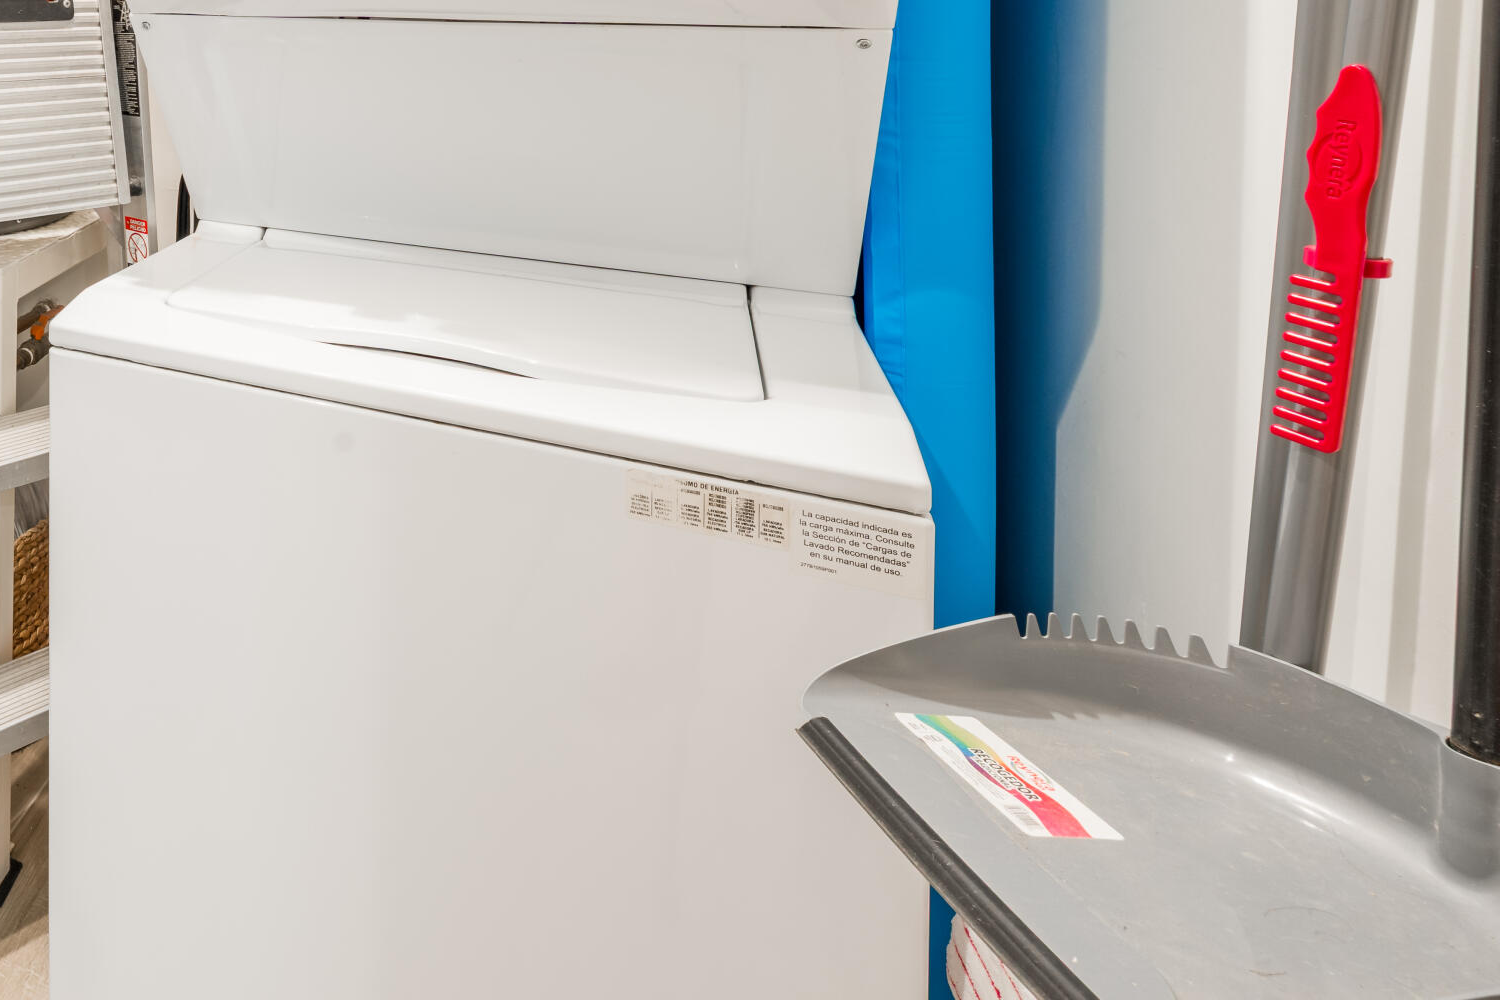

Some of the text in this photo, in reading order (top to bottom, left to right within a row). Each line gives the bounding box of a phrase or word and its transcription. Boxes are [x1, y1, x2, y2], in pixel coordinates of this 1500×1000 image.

[1326, 119, 1356, 199] Reynera
[802, 510, 813, 518] La
[815, 513, 860, 528] capacidad
[861, 522, 899, 536] indicada
[809, 522, 834, 532] carga
[835, 526, 872, 540] máxima.
[875, 534, 915, 549] Consulte
[803, 539, 835, 552] Lavado
[812, 531, 846, 544] Sección
[849, 539, 860, 548] de
[900, 550, 912, 558] de
[809, 551, 820, 559] en
[835, 557, 868, 569] manual
[870, 564, 881, 572] de
[970, 748, 1039, 800] RECOGEDOR
[1006, 755, 1056, 792] Reynera
